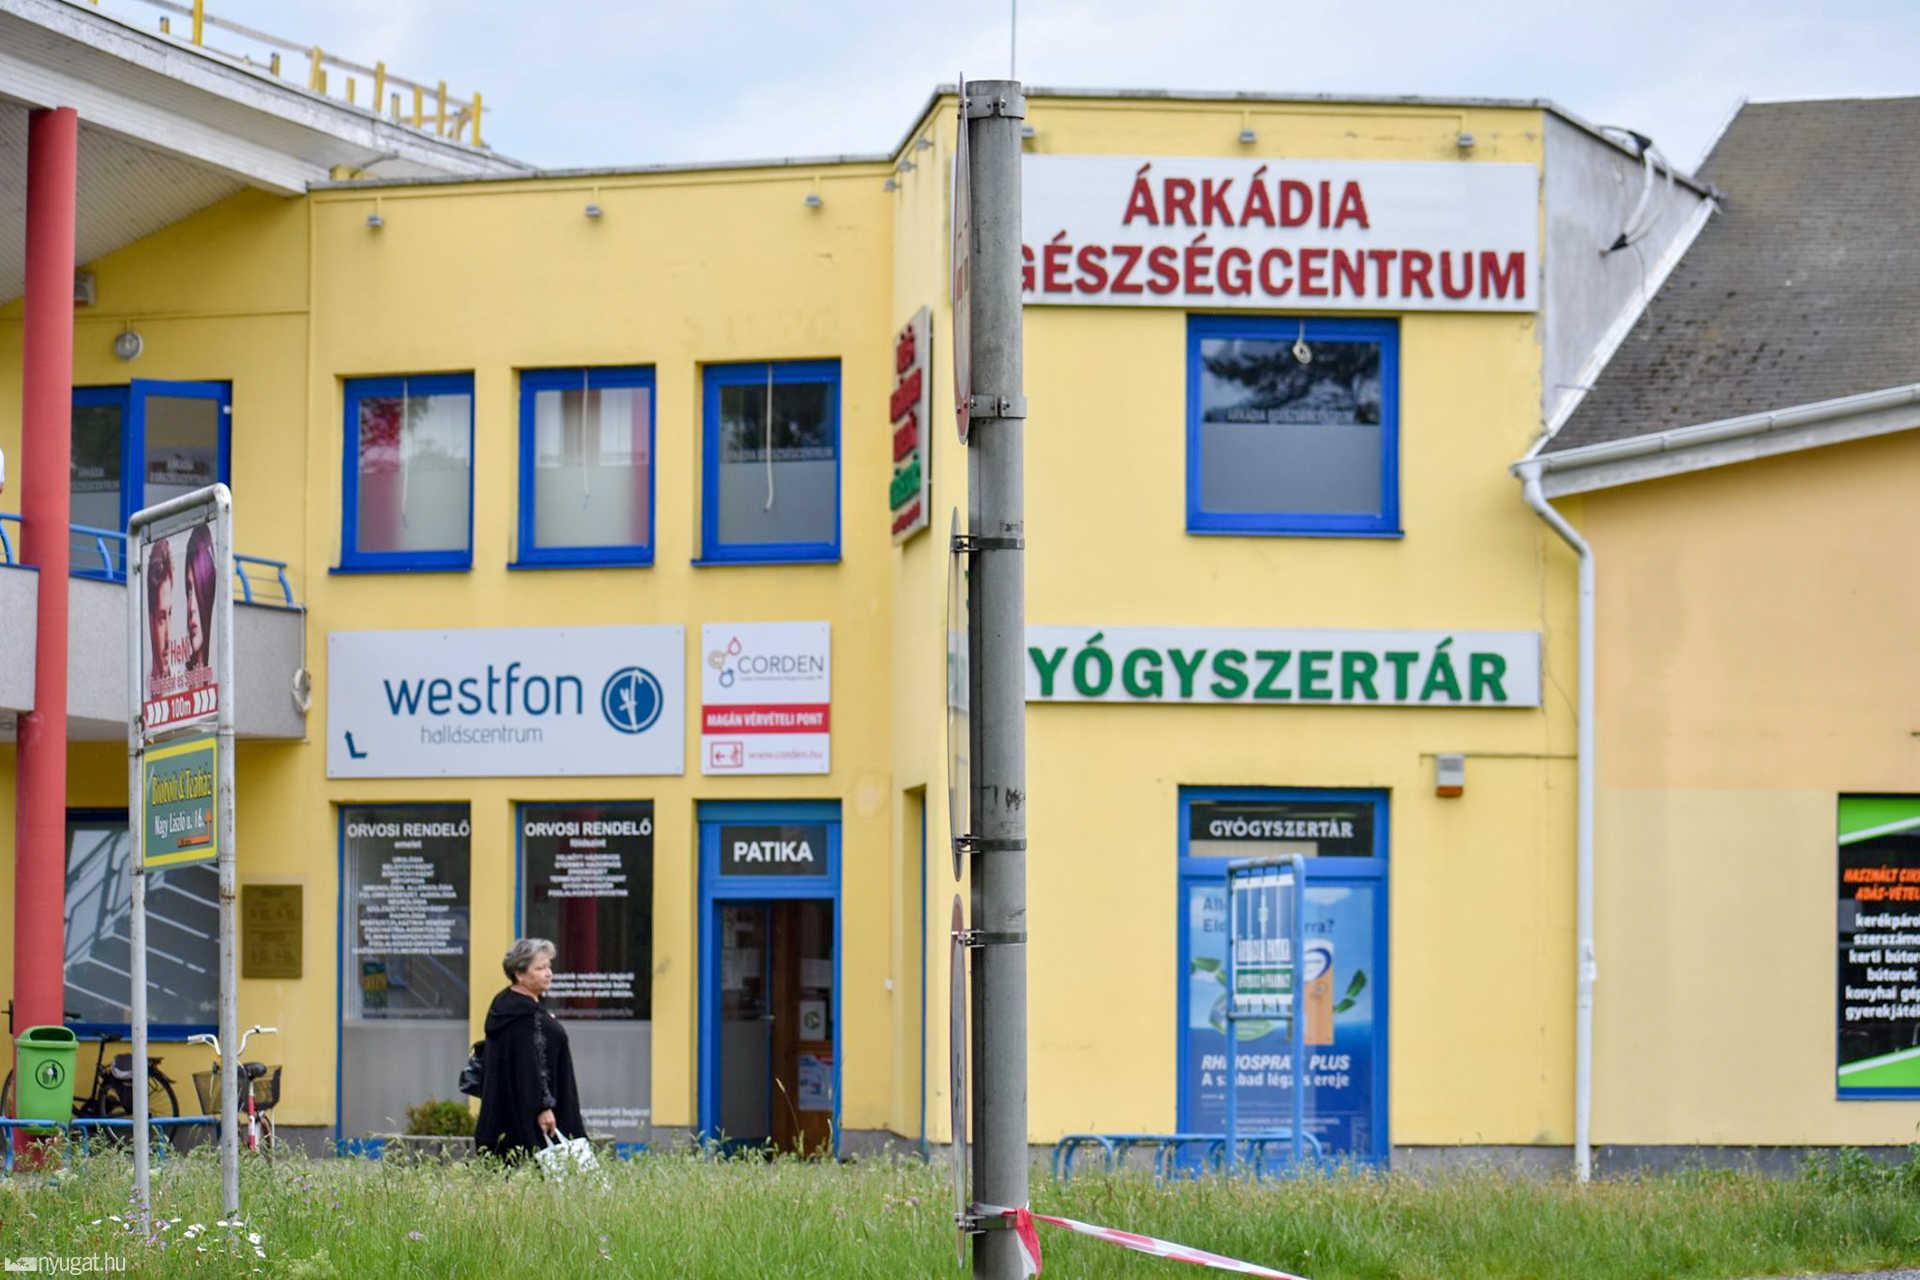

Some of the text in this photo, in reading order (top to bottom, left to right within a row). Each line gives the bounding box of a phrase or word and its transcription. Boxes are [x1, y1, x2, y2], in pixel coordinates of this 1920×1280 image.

[1122, 163, 1370, 229] ÁRKÁDIA
[737, 655, 825, 674] CORDEN
[383, 661, 584, 716] westfon
[706, 711, 742, 727] MAGÁN
[796, 711, 824, 726] PONT
[420, 723, 544, 745] halláscentrum
[347, 818, 470, 838] ORVOSI RENDELŐ
[524, 817, 653, 837] ORVOSI RENDELŐ
[1208, 816, 1355, 838] GYÓGYSZERTÁR
[733, 840, 814, 862] PATIKA
[1849, 949, 1882, 964] kerti
[1866, 967, 1918, 982] bútorok
[1845, 985, 1898, 1003] konyhai
[1309, 1054, 1351, 1070] PLUS
[1202, 1072, 1213, 1086] A
[1313, 1071, 1351, 1090] ereje
